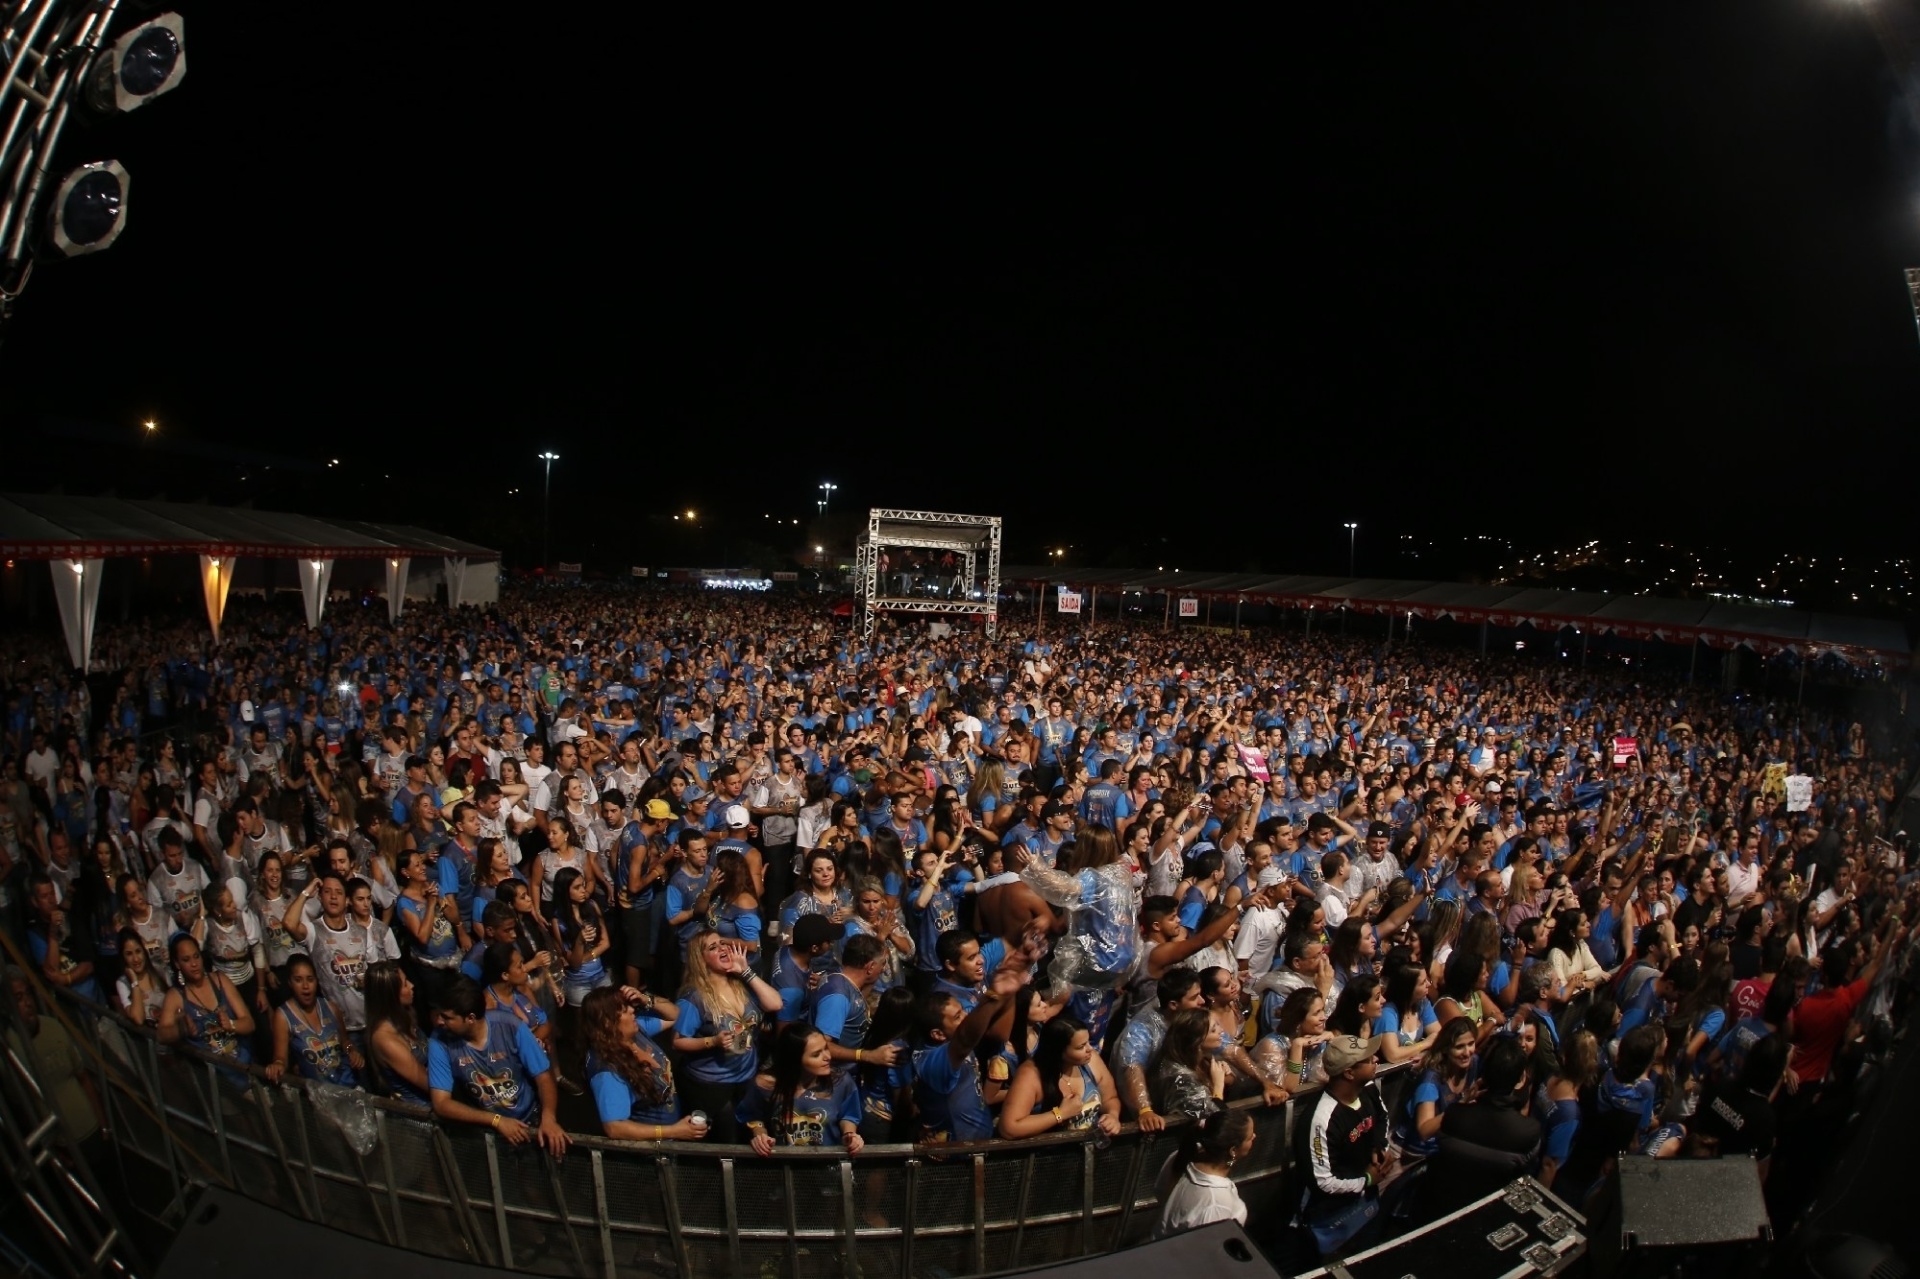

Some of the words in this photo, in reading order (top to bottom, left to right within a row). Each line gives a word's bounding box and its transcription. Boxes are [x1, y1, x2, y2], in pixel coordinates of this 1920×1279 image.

[1061, 595, 1079, 610] SAÍDA
[172, 896, 199, 912] Ouro
[467, 1080, 514, 1098] Ouro
[1711, 1096, 1745, 1131] PRODUÇÃO
